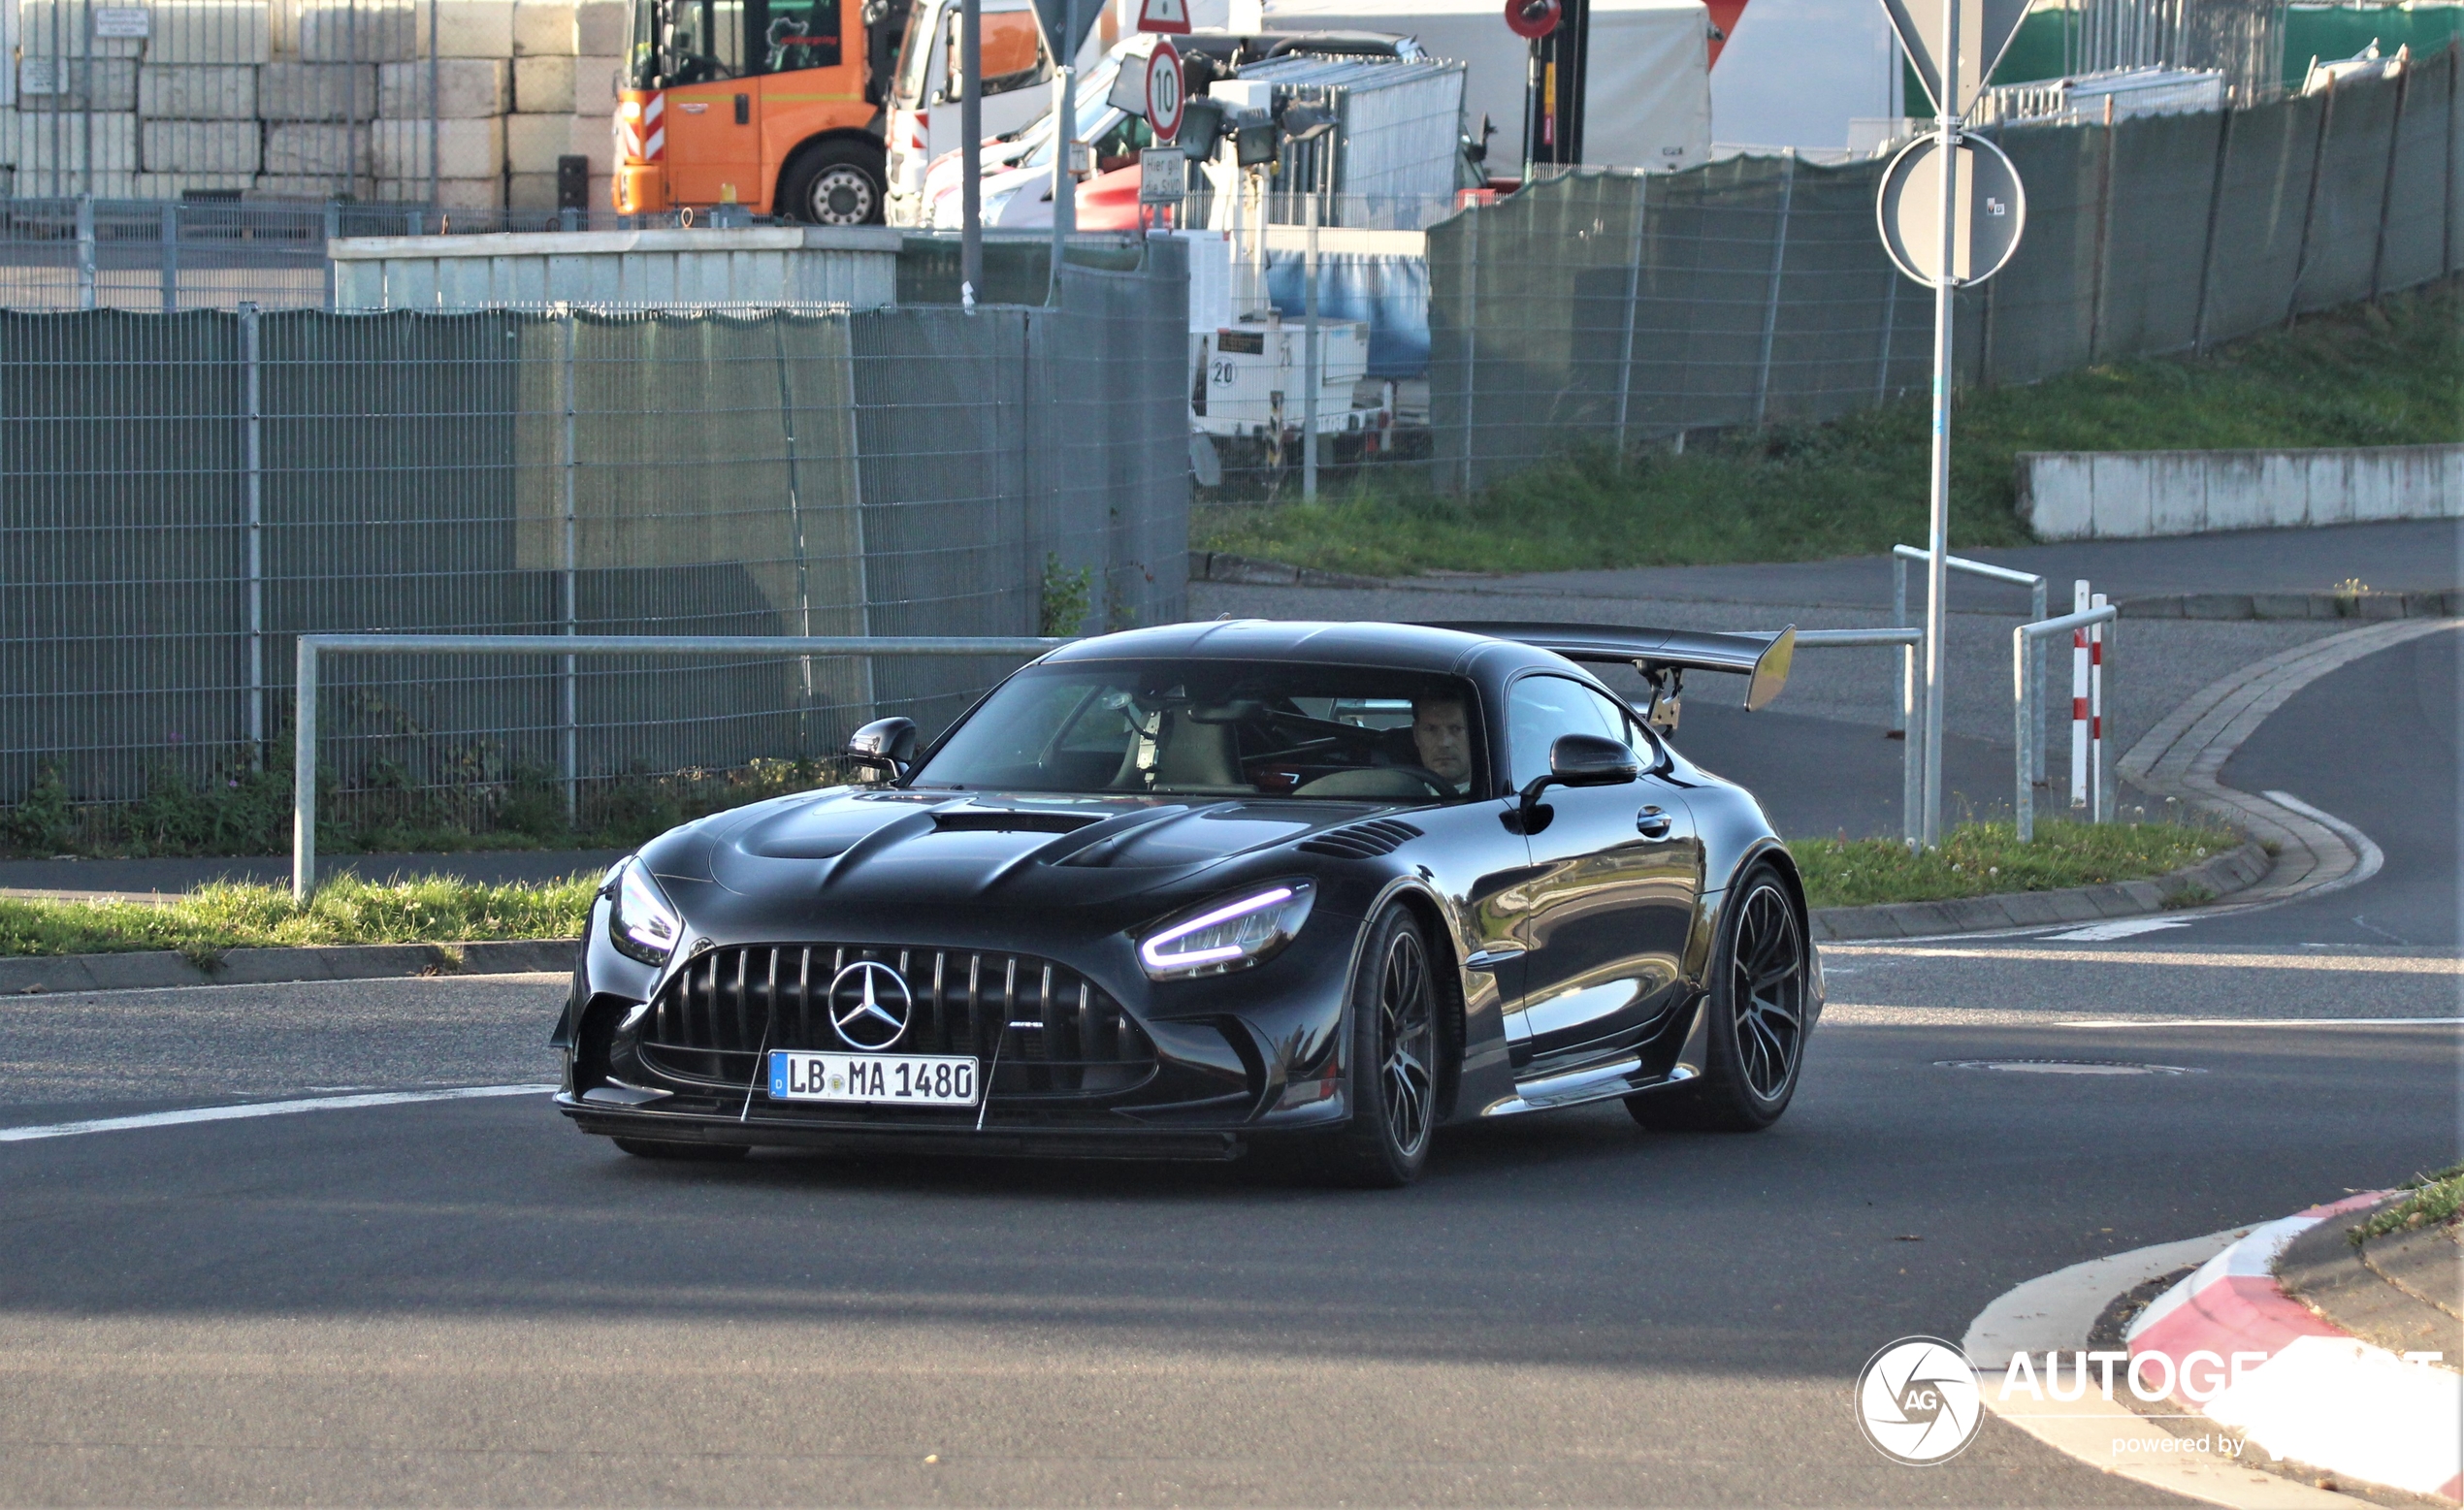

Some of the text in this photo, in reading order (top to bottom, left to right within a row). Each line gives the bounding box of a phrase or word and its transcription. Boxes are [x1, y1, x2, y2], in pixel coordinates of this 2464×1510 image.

[1155, 70, 1174, 112] 10
[1147, 156, 1181, 176] Hier gilt
[1146, 179, 1158, 192] die
[1214, 362, 1233, 383] 20
[776, 1079, 783, 1089] D
[790, 1059, 972, 1098] LB MA 1480
